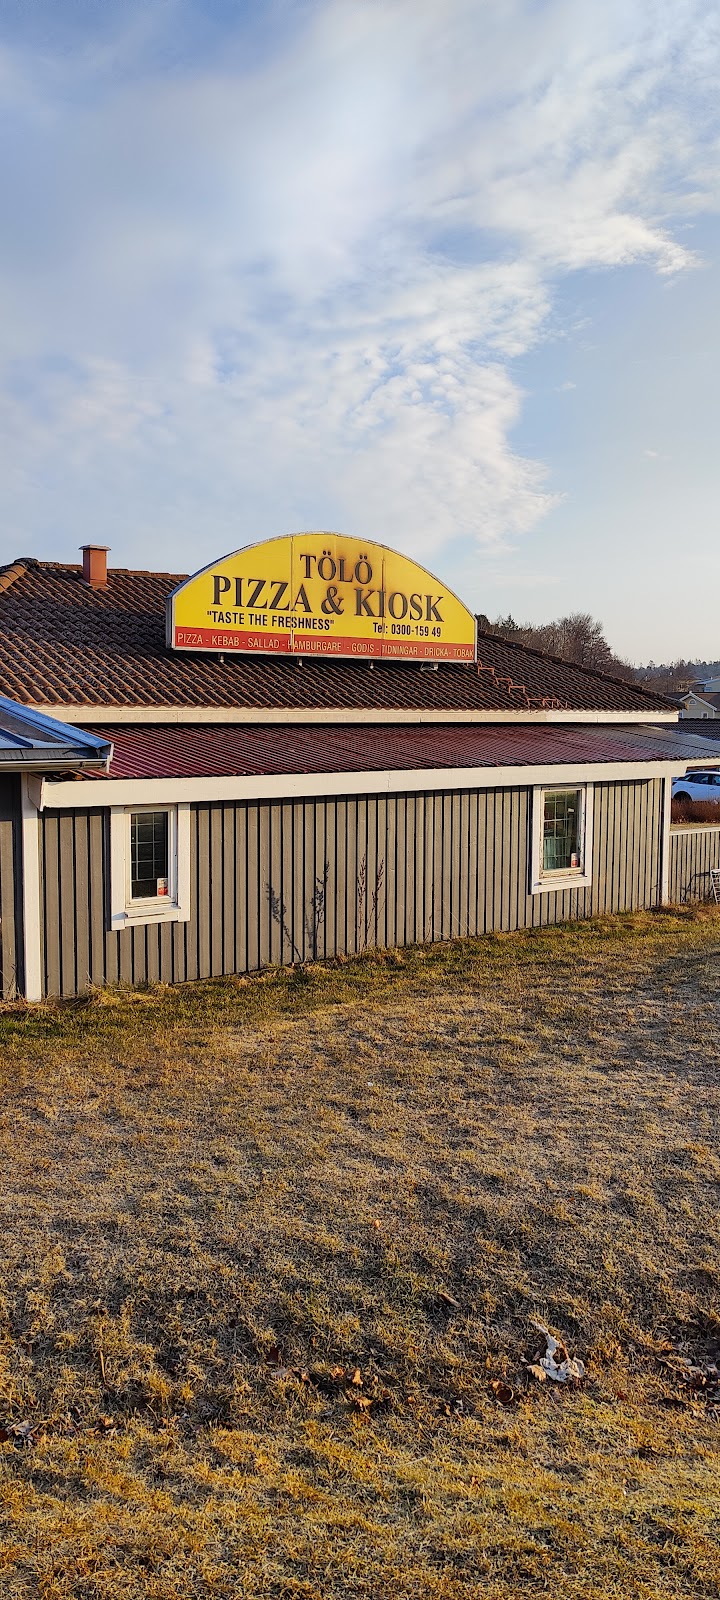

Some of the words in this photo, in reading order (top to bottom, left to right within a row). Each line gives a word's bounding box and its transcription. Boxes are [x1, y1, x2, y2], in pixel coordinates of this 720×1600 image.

[300, 550, 372, 584] TÖLÖ
[211, 575, 313, 613] PIZZA
[321, 586, 344, 615] &
[354, 588, 444, 622] KIOSK
[207, 611, 244, 624] "TASTE
[248, 614, 268, 626] THE
[373, 622, 388, 634] Tel:
[392, 624, 428, 636] 0300-159
[432, 627, 441, 637] 49
[178, 633, 202, 644] PIZZA
[212, 636, 240, 646] KEBAB
[248, 638, 280, 648] SALLAD
[288, 640, 342, 651] HAMBURGARE
[352, 642, 374, 653] GODIS
[382, 644, 418, 655] TIDNINGAR
[454, 648, 474, 658] TOBAK
